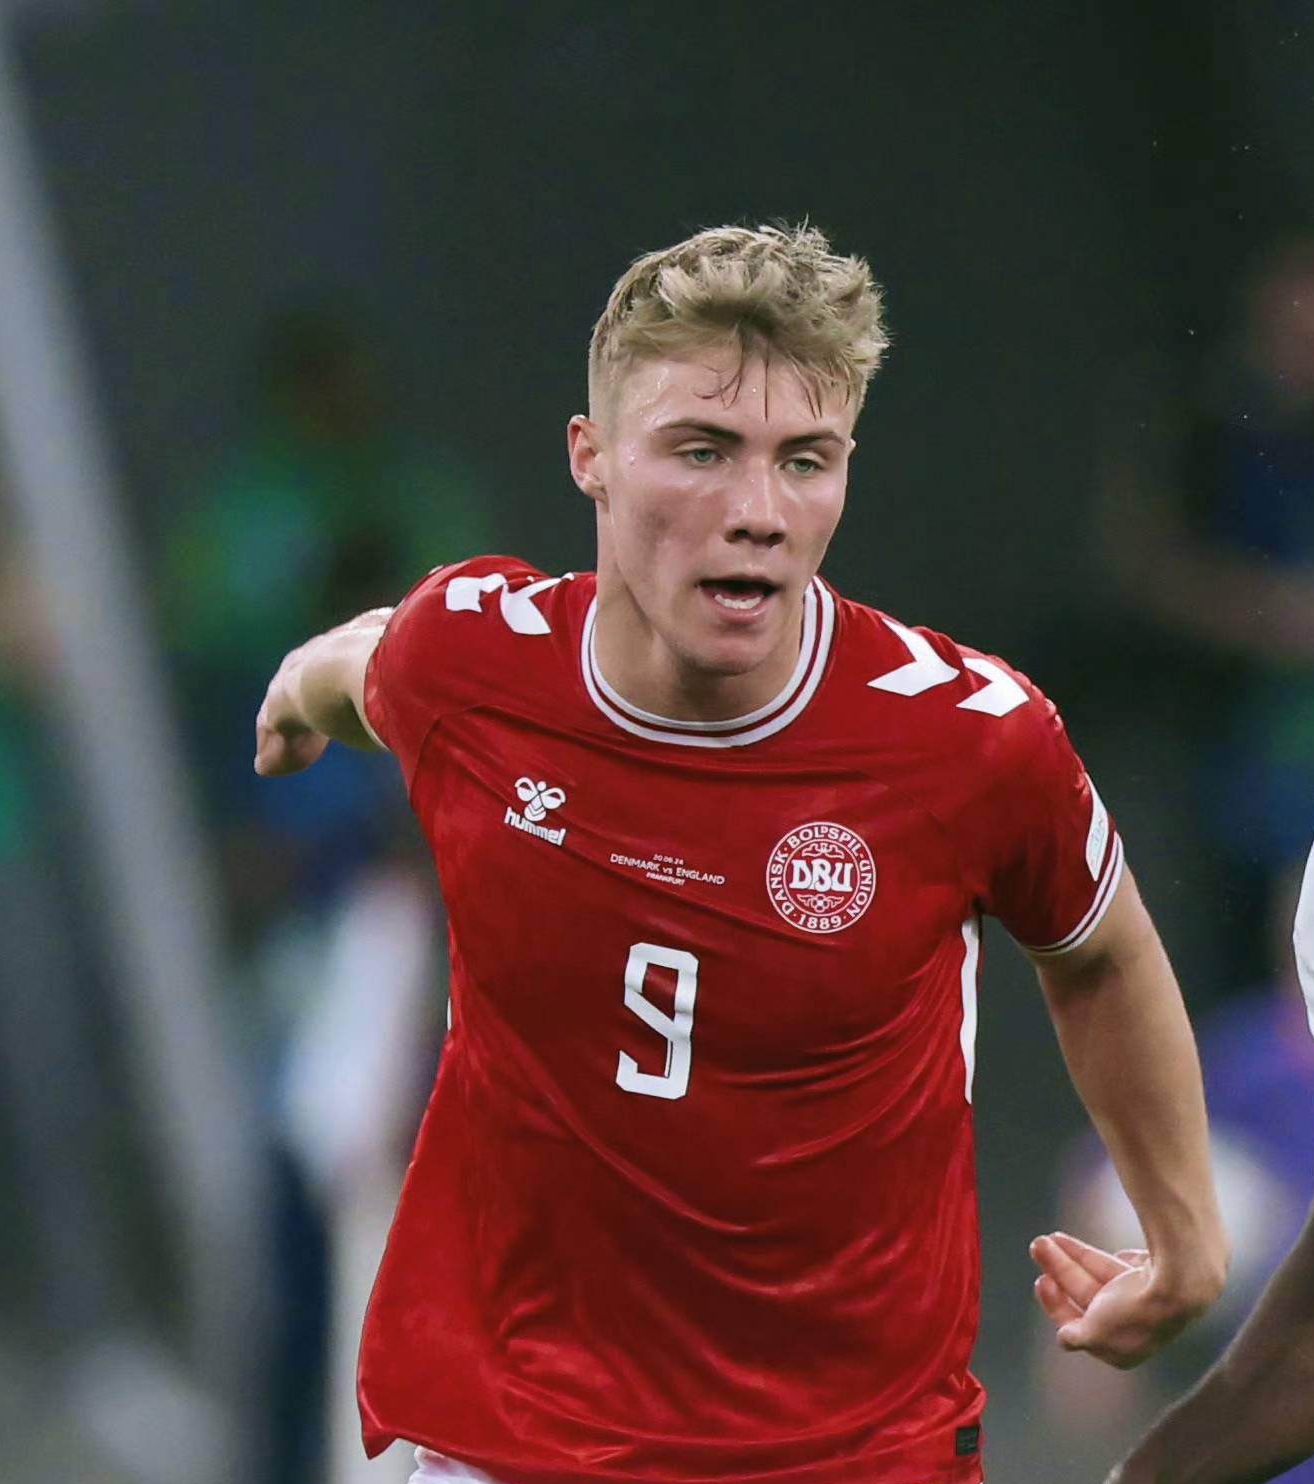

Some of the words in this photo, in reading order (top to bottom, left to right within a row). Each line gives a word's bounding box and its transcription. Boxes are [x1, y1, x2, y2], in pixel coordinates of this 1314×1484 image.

[504, 806, 567, 846] hummel
[610, 853, 660, 872] DENMARK
[675, 867, 726, 886] ENGLAND
[770, 849, 795, 916] DANSK
[846, 860, 872, 918] UNION
[789, 858, 854, 892] DBU
[797, 914, 842, 930] 1889
[615, 942, 700, 1100] 9
